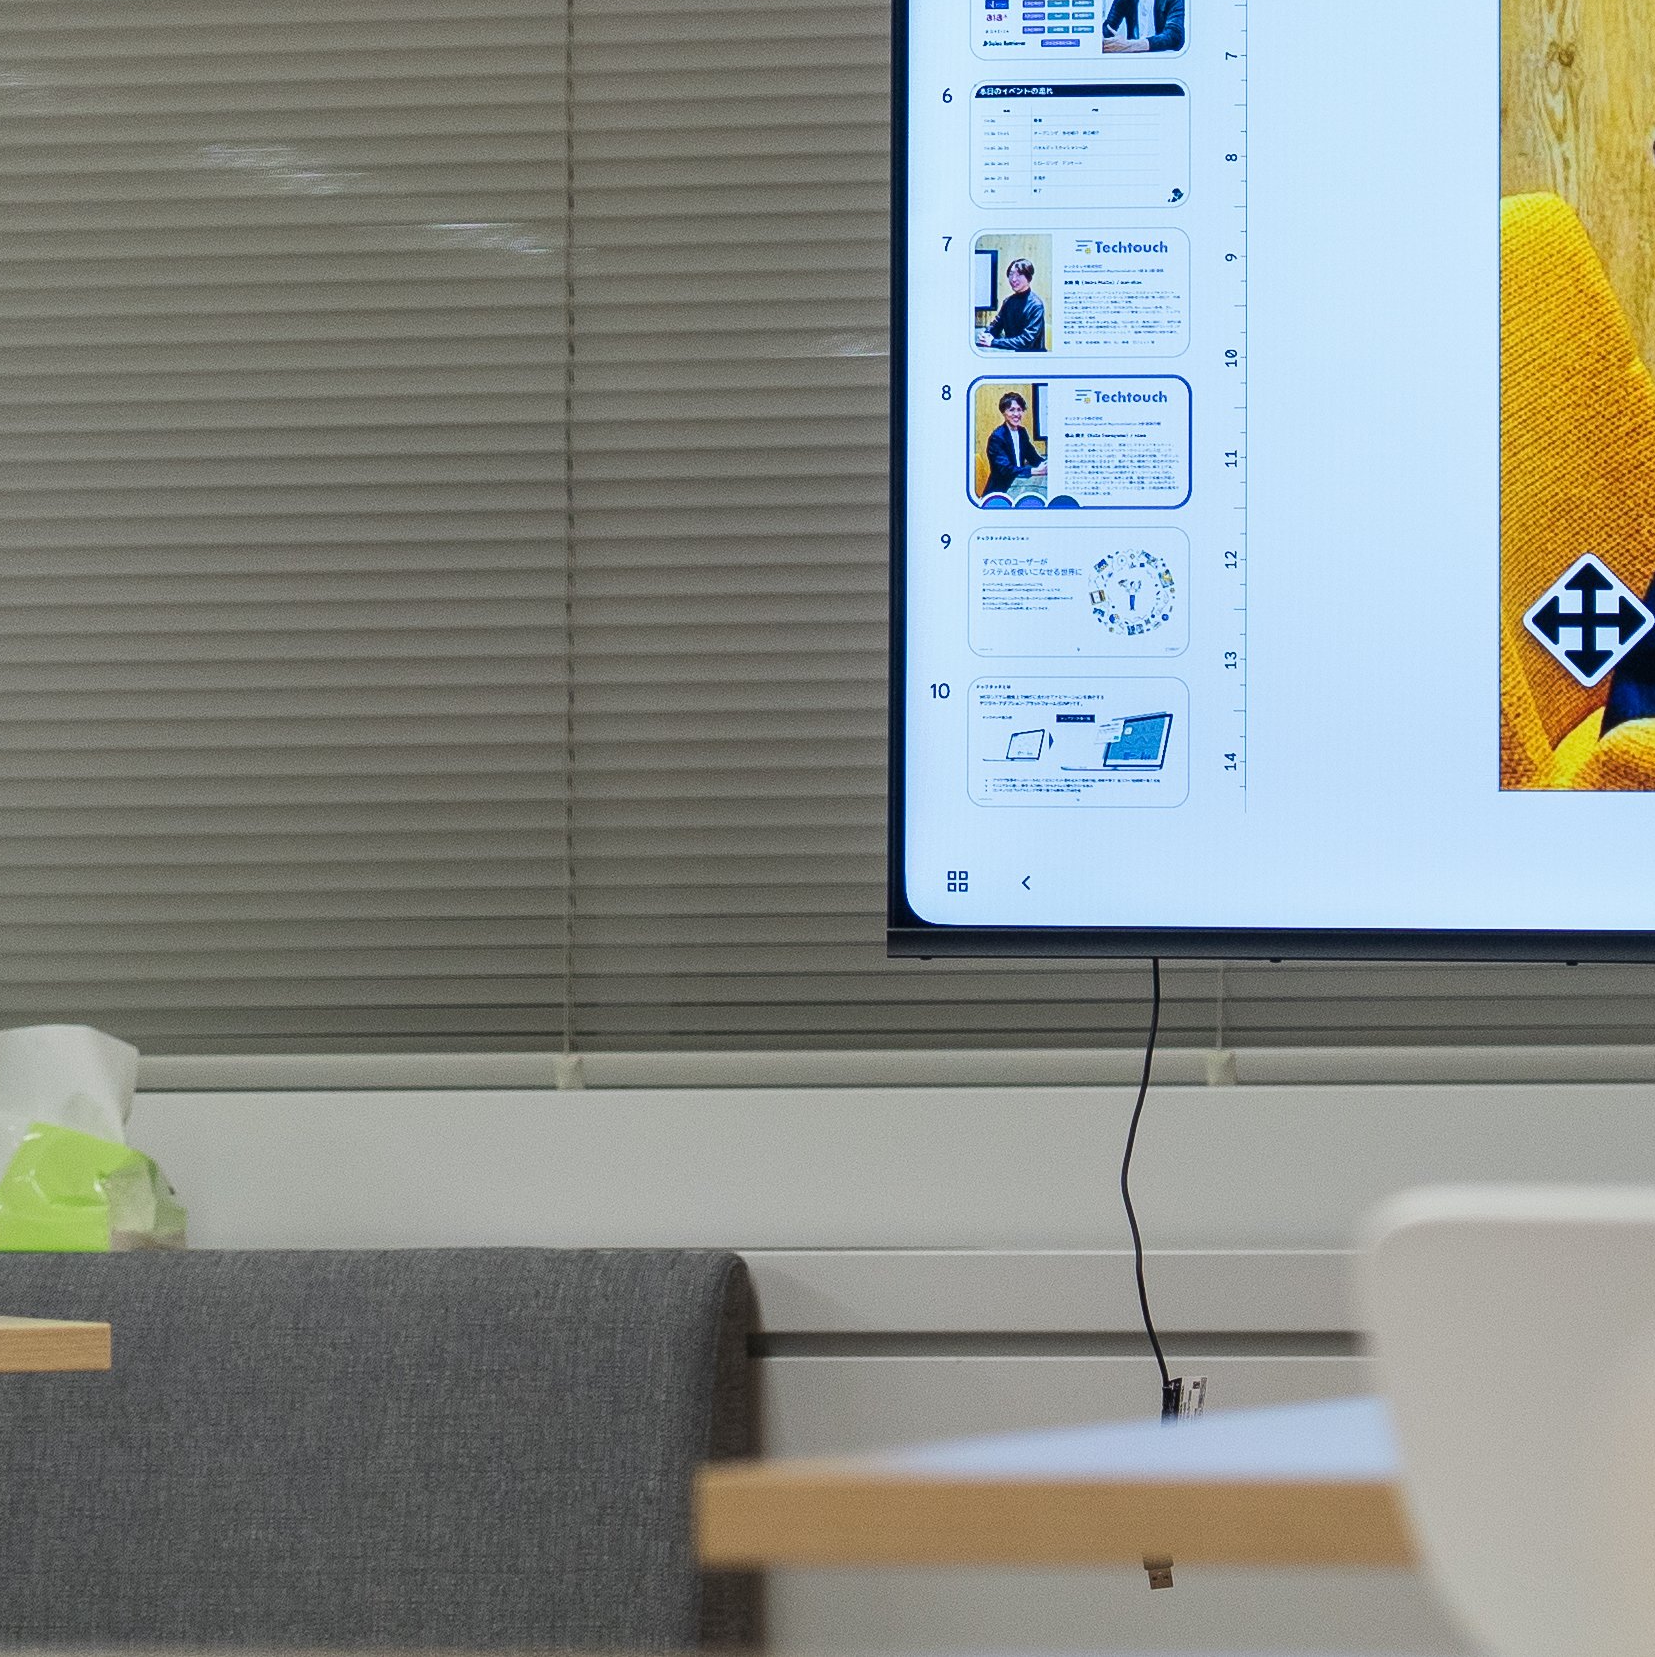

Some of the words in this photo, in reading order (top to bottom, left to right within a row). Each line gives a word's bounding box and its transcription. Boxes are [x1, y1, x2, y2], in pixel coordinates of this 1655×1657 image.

[1226, 52, 1237, 60] 7
[943, 88, 952, 103] 6
[942, 237, 952, 251] 7
[1095, 241, 1168, 254] Techtouch
[1225, 350, 1237, 367] 10
[942, 385, 951, 400] 8
[1094, 391, 1168, 403] Techtouch
[1225, 450, 1237, 467] 11
[941, 534, 951, 549] 9
[1225, 551, 1237, 568] 12
[1225, 652, 1237, 669] 13
[931, 683, 950, 698] 10
[1224, 753, 1236, 770] 14
